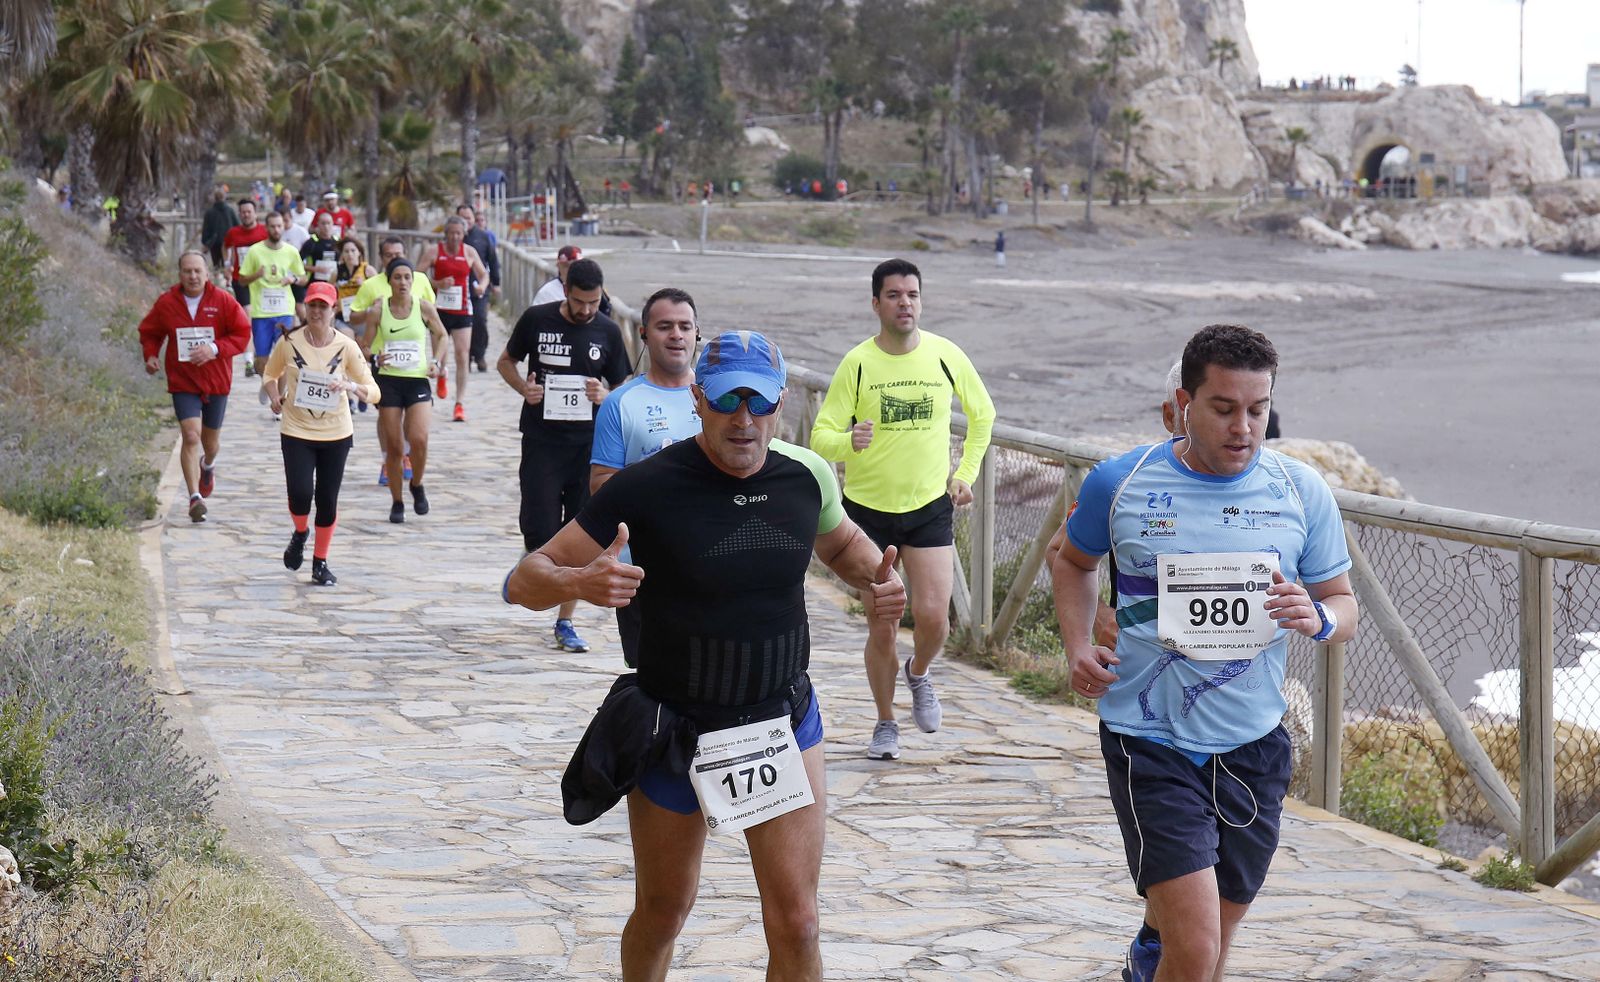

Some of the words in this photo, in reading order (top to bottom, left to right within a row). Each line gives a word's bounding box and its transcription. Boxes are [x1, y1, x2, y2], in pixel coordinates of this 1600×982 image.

[538, 332, 564, 344] BDY
[537, 344, 572, 356] CMBT
[394, 353, 412, 362] 102
[886, 380, 917, 388] CARRERA
[307, 386, 330, 400] 845
[562, 394, 578, 406] 18
[1222, 506, 1240, 517] edp
[1188, 598, 1250, 627] 980
[702, 742, 736, 751] Ayuntamiento
[721, 763, 778, 800] 170
[730, 810, 756, 822] CARRERA
[756, 800, 781, 813] POPULAR
[788, 791, 804, 799] PALO
